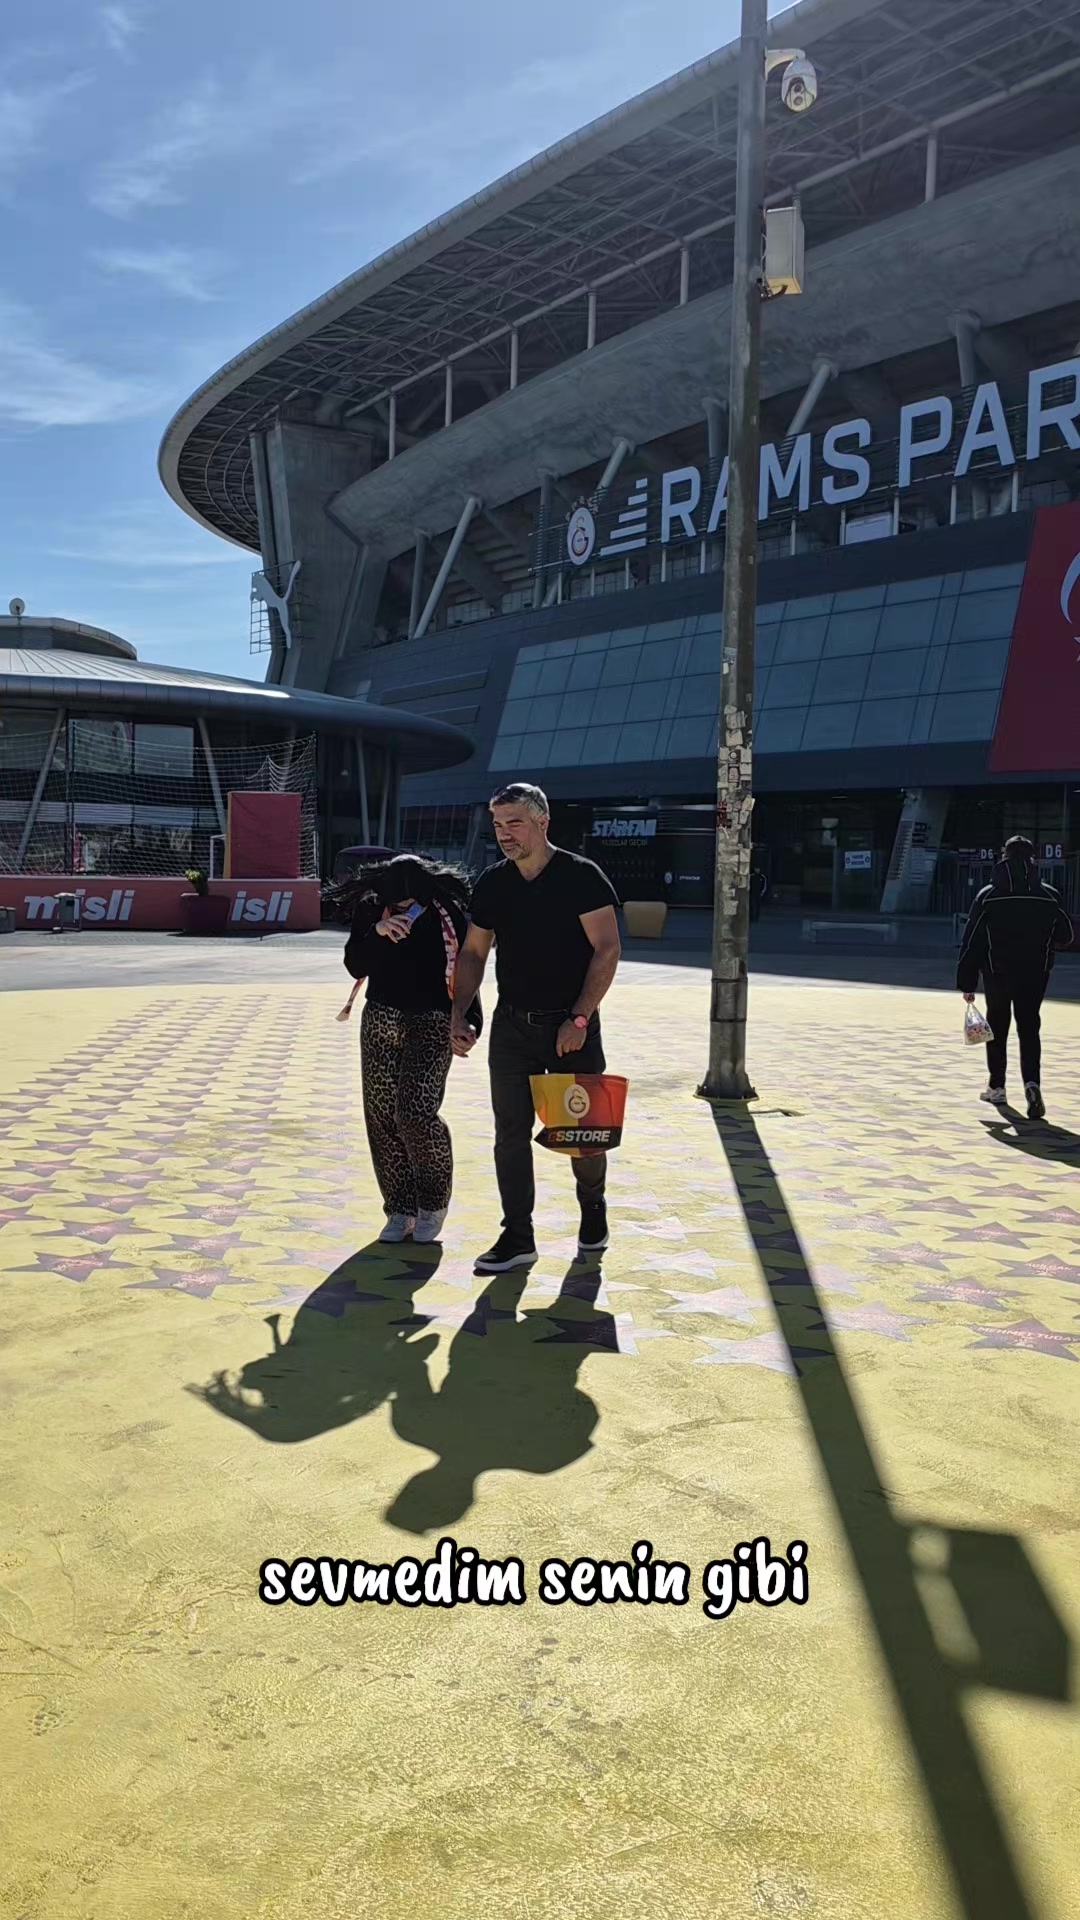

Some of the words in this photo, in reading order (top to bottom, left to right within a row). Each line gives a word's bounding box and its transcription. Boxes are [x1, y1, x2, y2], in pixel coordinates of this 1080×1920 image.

[980, 849, 994, 860] D6
[1045, 844, 1062, 858] D6
[24, 888, 135, 921] misli
[231, 890, 293, 922] isli
[977, 1326, 1034, 1337] MEHMET
